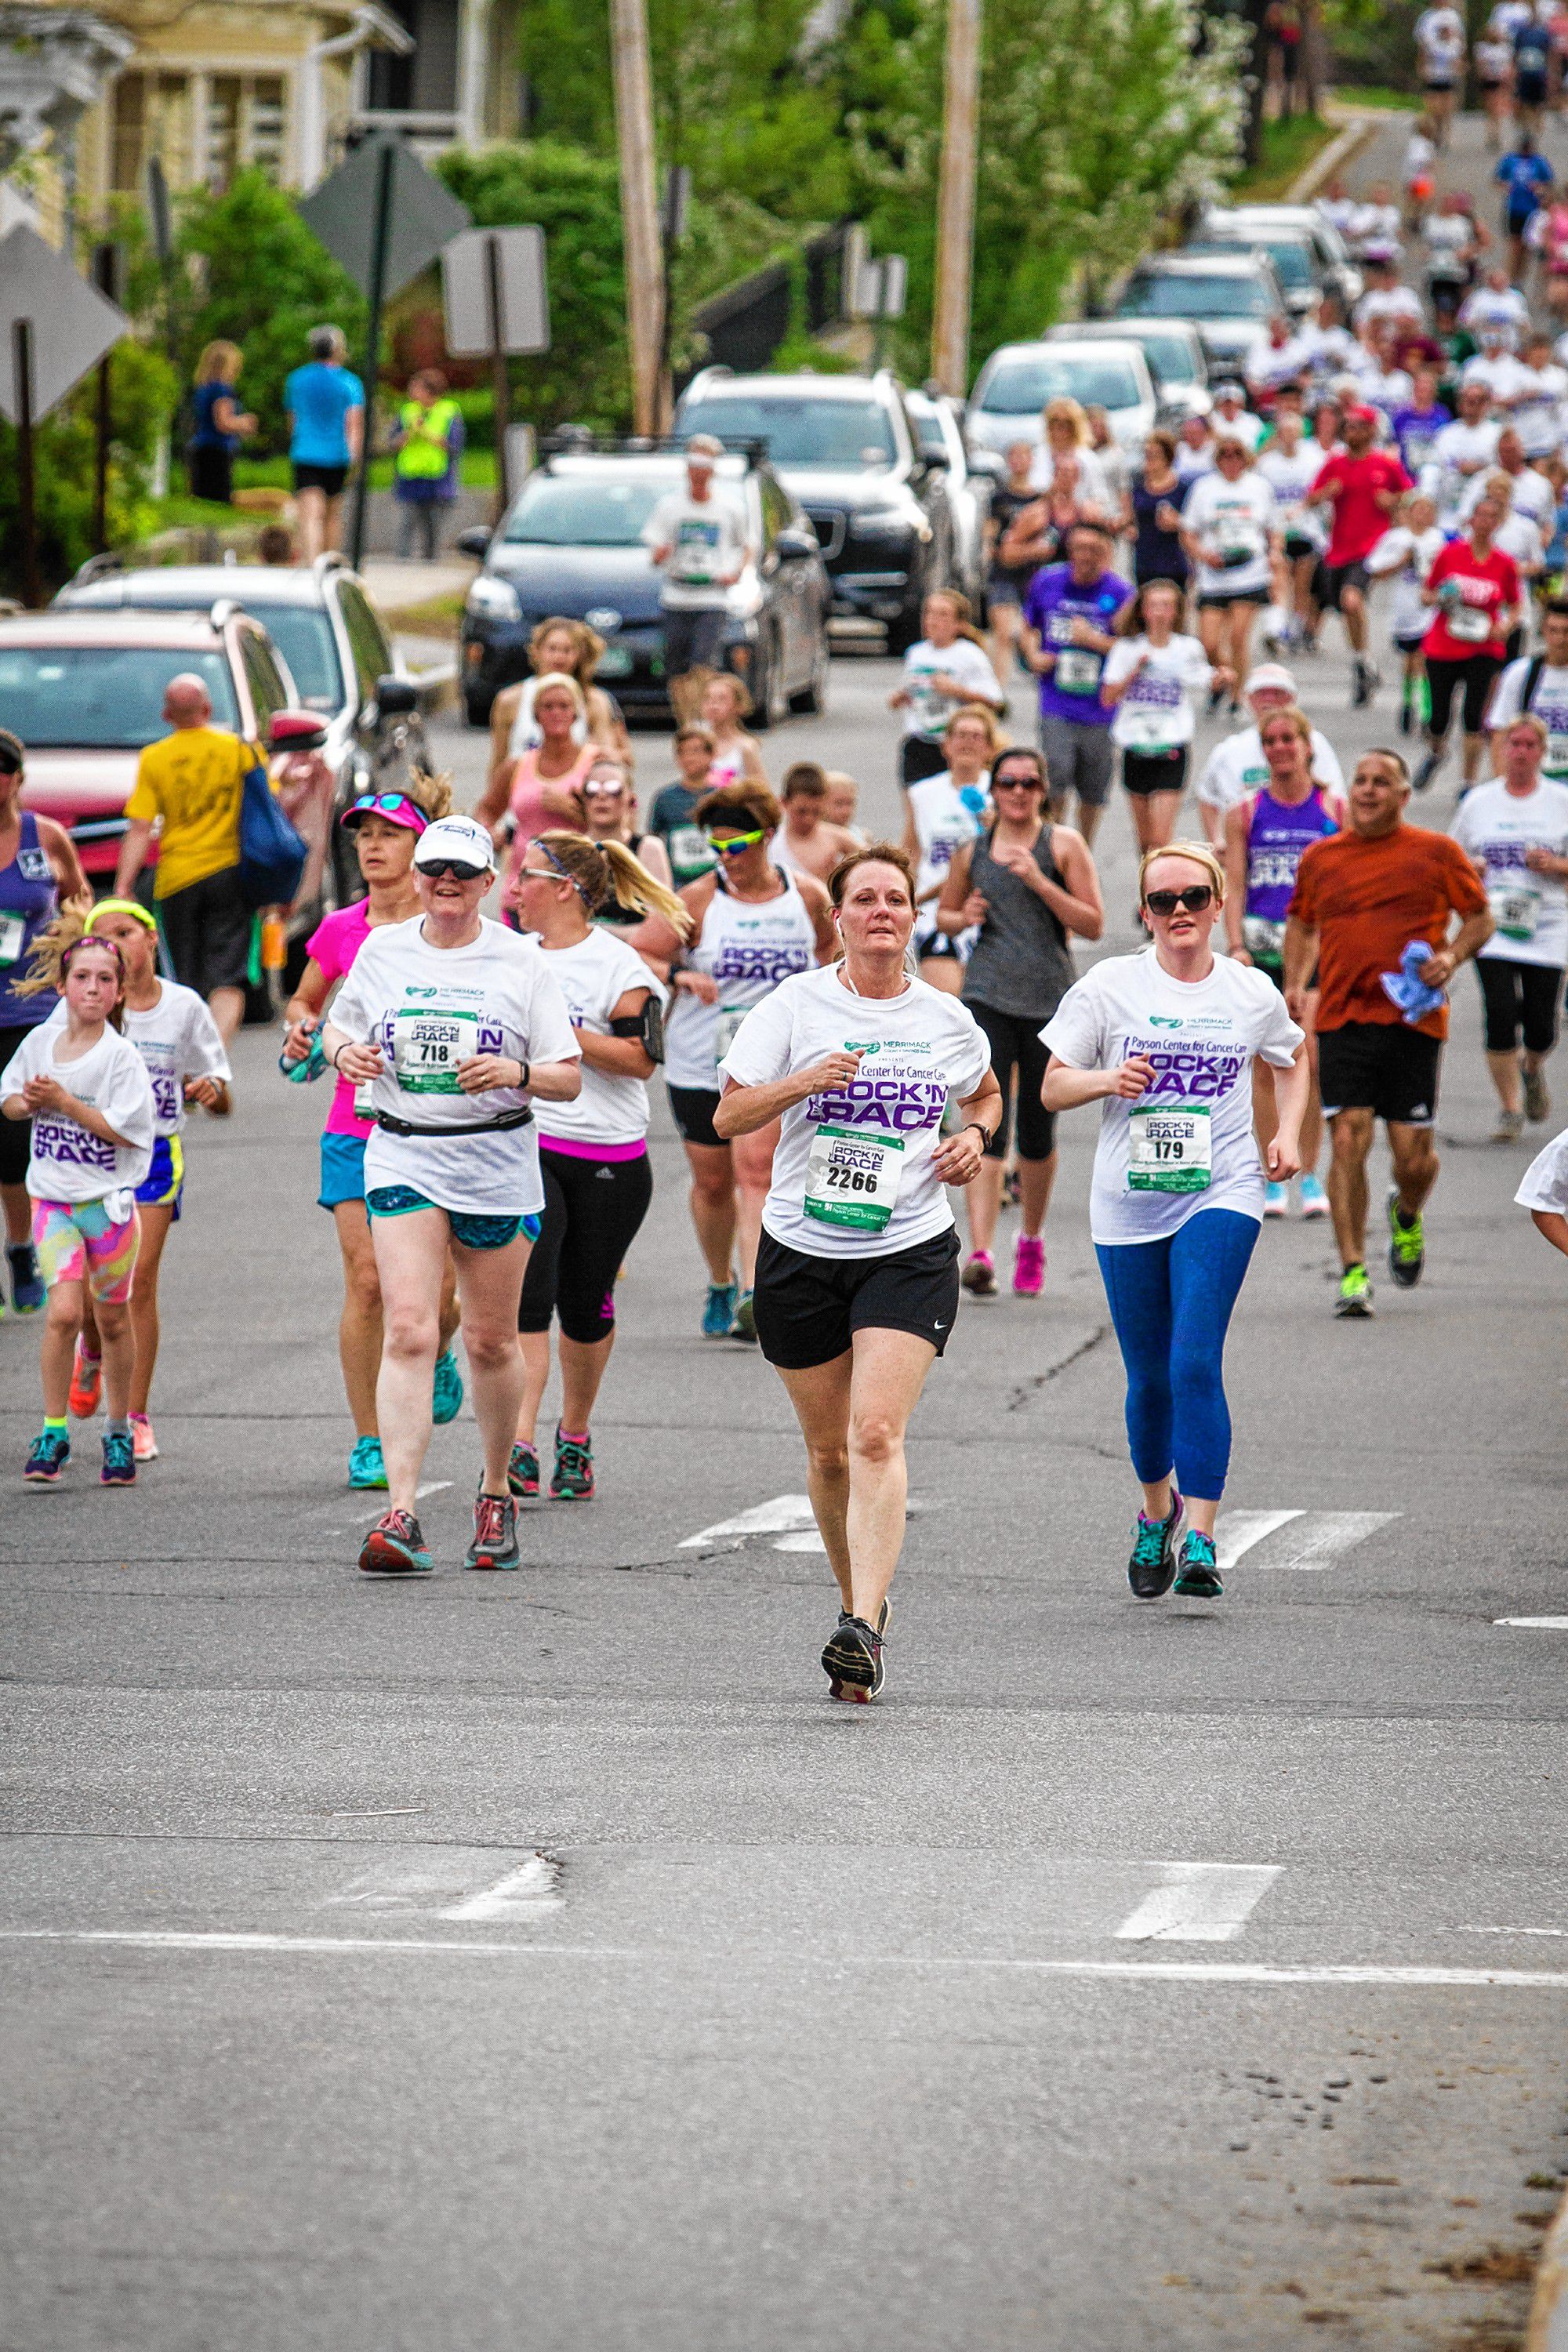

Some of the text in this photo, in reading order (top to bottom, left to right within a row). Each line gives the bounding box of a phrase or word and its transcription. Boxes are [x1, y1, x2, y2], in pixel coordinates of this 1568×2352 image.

[416, 1031, 459, 1043] RACE
[883, 1040, 931, 1049] MERRIMACK
[1131, 1036, 1161, 1051] Payson
[1163, 1038, 1191, 1051] Center
[1192, 1040, 1204, 1053] for
[1206, 1040, 1234, 1054] Cancer
[420, 1044, 448, 1062] 718
[862, 1065, 891, 1077] Center
[892, 1065, 905, 1079] for
[907, 1066, 934, 1080] Cancer
[822, 1101, 946, 1131] RACE
[1149, 1129, 1195, 1138] RACE
[834, 1146, 884, 1161] ROCK'N
[1155, 1141, 1184, 1160] 179
[833, 1153, 884, 1172] RACE
[826, 1166, 878, 1193] 2266
